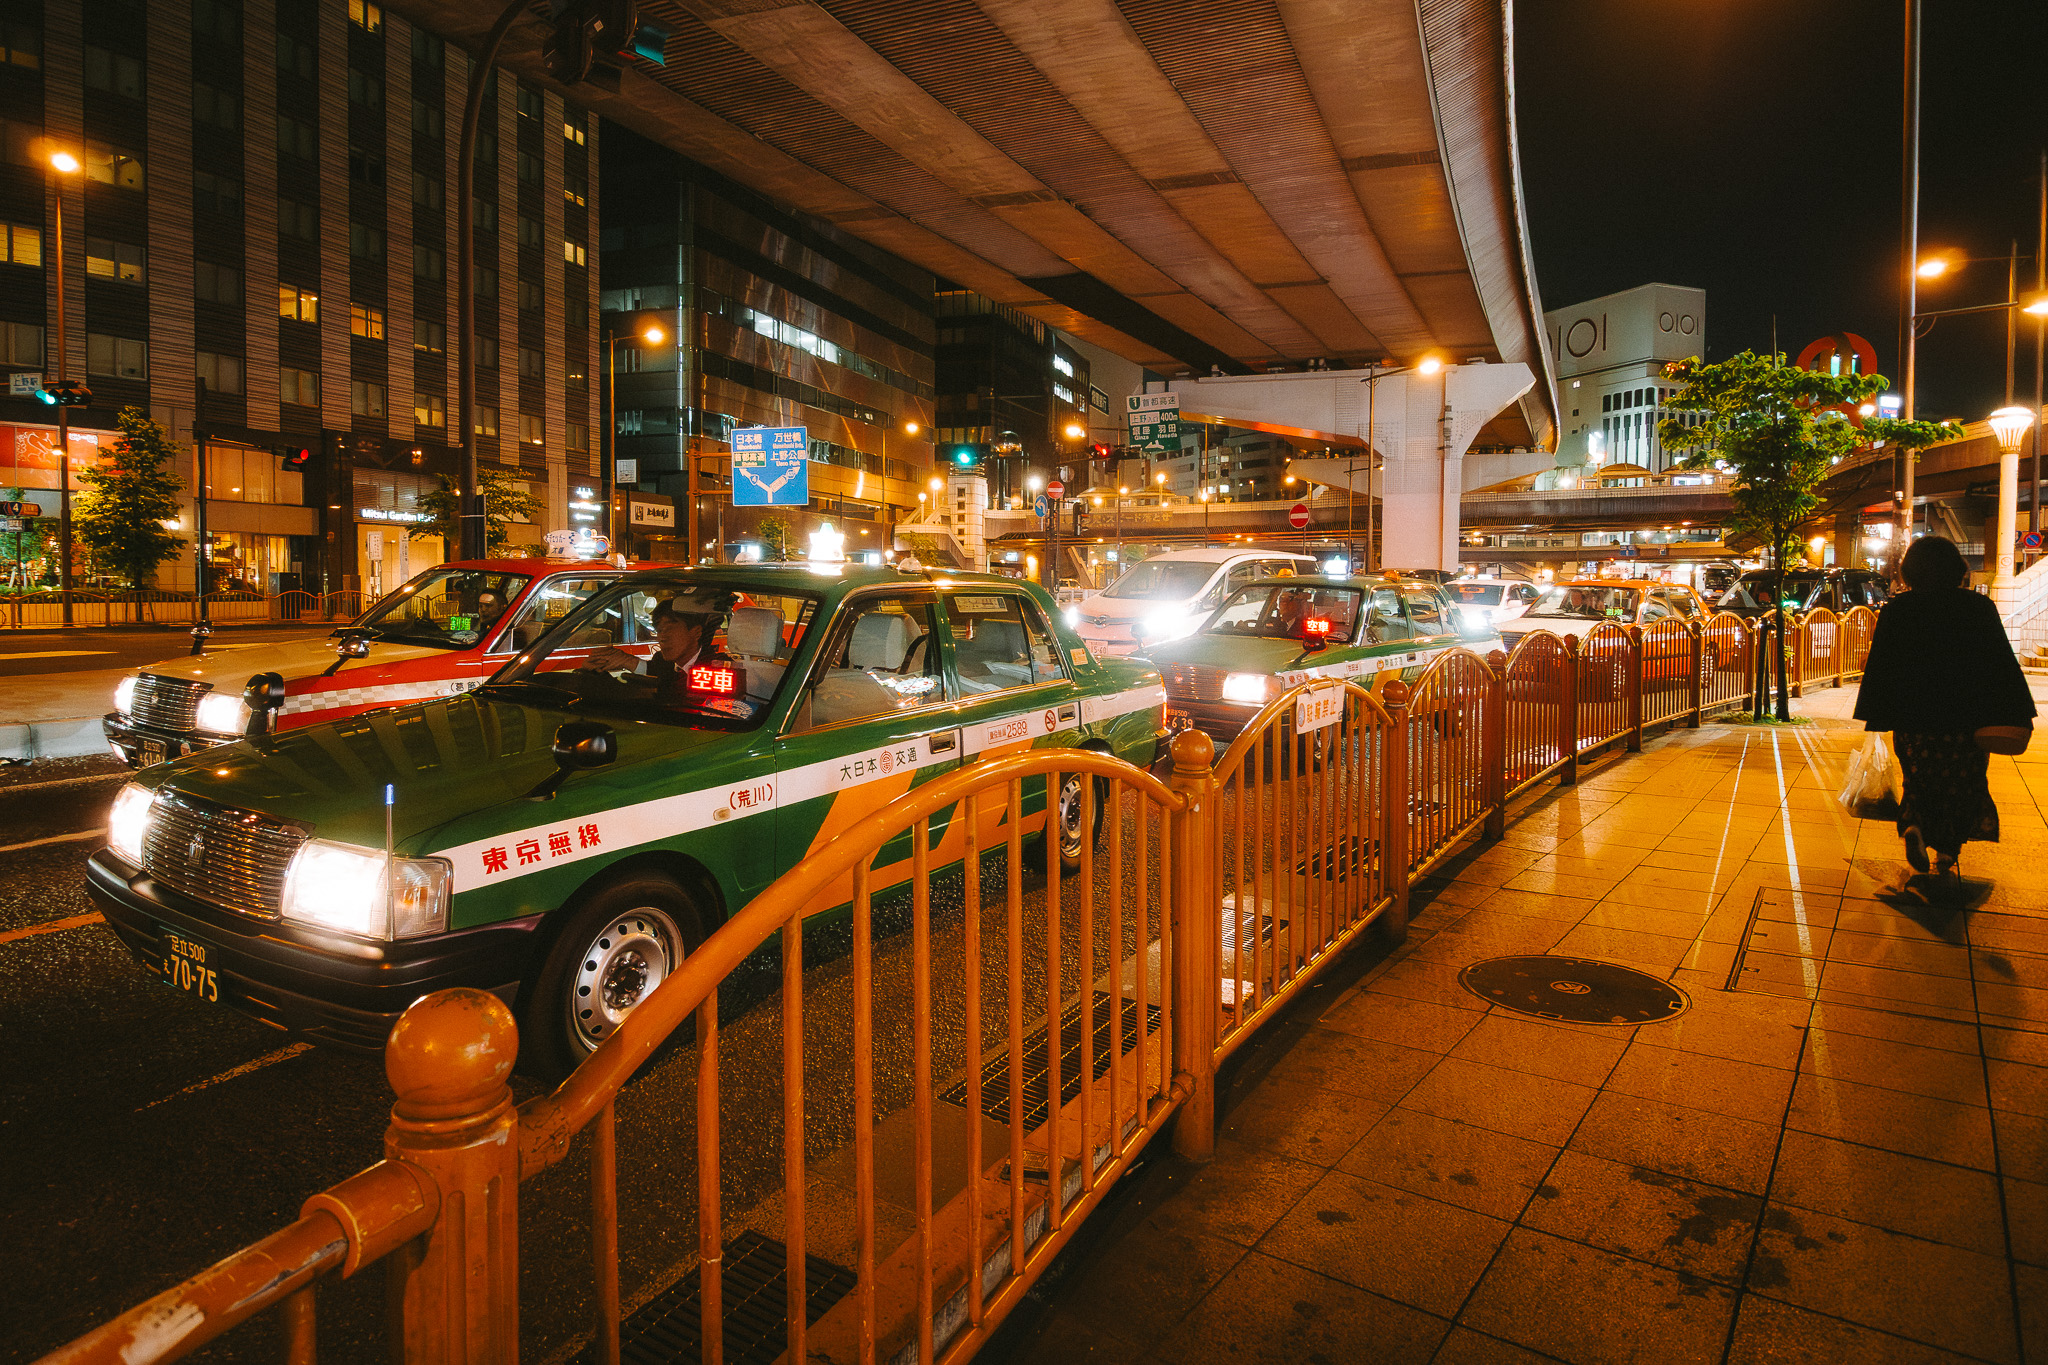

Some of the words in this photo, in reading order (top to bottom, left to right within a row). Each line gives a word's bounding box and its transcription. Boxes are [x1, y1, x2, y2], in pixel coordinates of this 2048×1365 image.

[1143, 396, 1176, 407] 首都高速
[1161, 412, 1178, 421] 400m
[1158, 424, 1176, 433] 羽田
[736, 434, 762, 444] 日本橋
[774, 432, 801, 442] 万世橋
[735, 452, 765, 461] 首都高速
[770, 450, 805, 460] 上野公園
[388, 511, 416, 521] Garden
[1307, 620, 1329, 632] 空車
[692, 667, 733, 692] 空車
[1006, 721, 1028, 738] 2589
[840, 757, 878, 782] 大日本
[895, 746, 918, 767] 交通
[729, 783, 774, 810] (荒川)
[481, 823, 602, 875] 東京無線
[170, 935, 206, 963] 足立500
[170, 954, 218, 1003] 70-75
